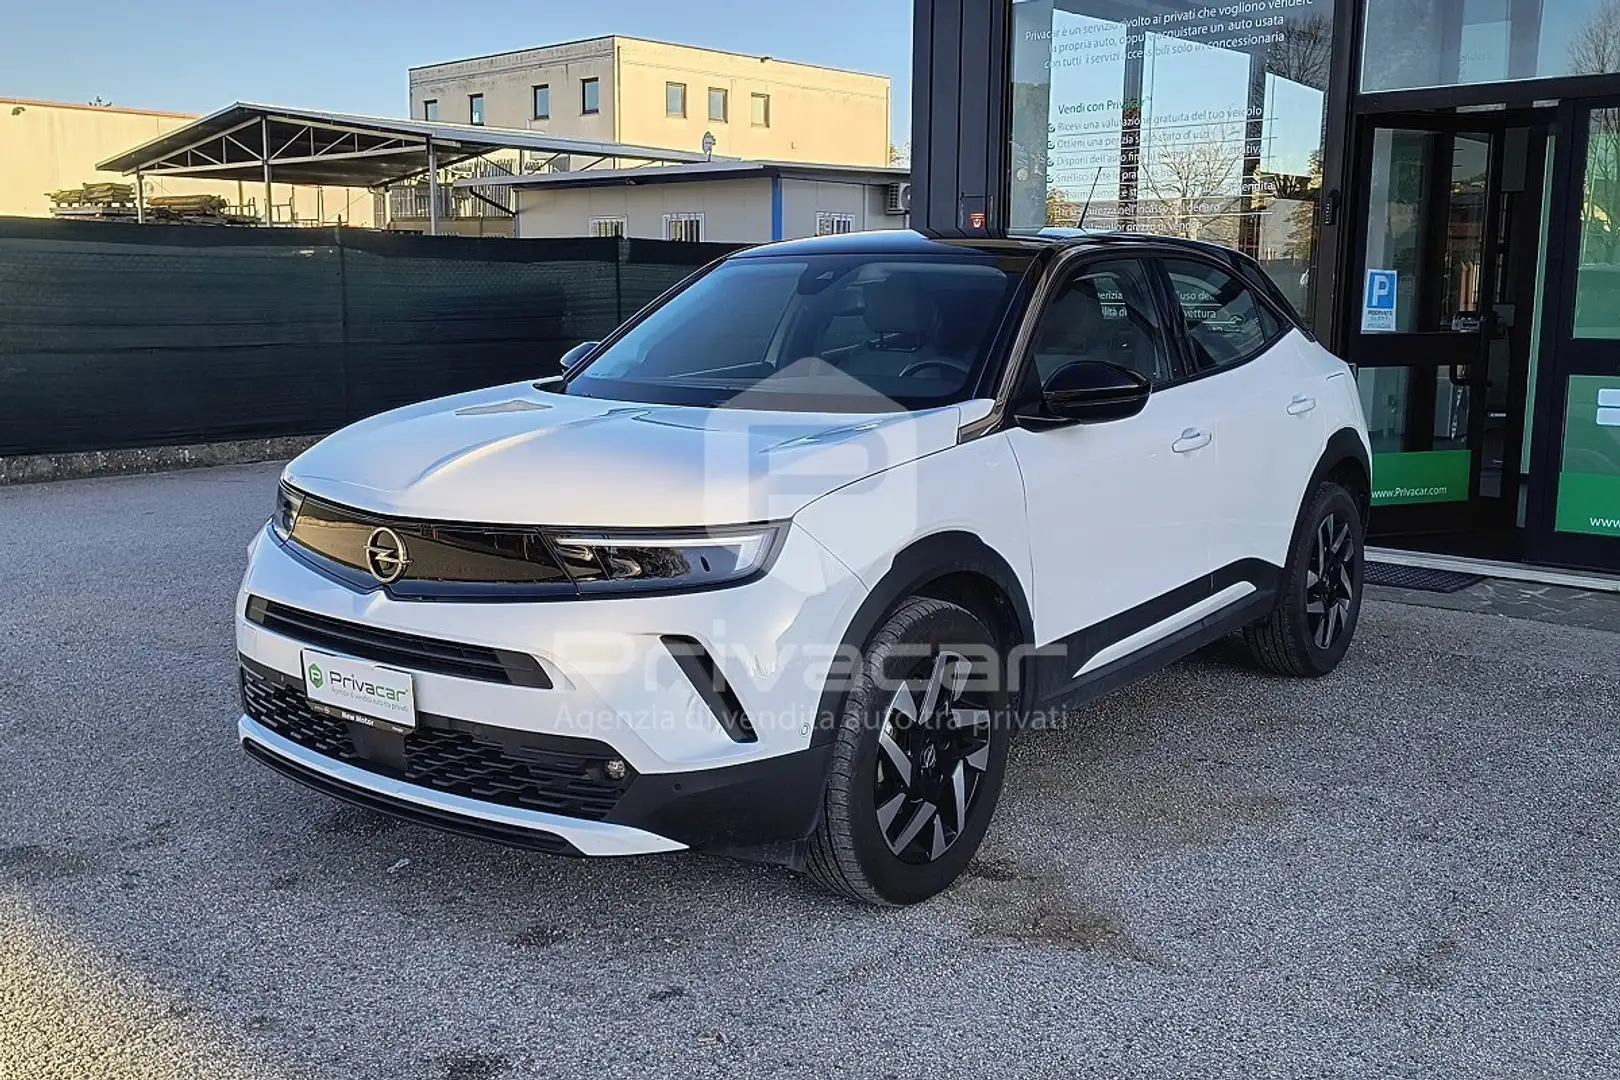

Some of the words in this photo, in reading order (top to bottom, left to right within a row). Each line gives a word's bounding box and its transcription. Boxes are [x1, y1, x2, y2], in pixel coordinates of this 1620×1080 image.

[1069, 27, 1081, 36] un
[1083, 21, 1117, 34] servizio
[1152, 14, 1162, 25] ai
[1163, 8, 1196, 25] privati
[1197, 7, 1217, 18] che
[1218, 0, 1266, 17] vogliono
[1059, 40, 1092, 54] propria
[1210, 23, 1225, 33] un
[1228, 19, 1253, 31] auto
[1255, 15, 1284, 27] usata
[1171, 42, 1193, 54] solo
[1207, 30, 1285, 49] concessionaria
[1058, 103, 1085, 115] Vendi
[1087, 102, 1104, 112] con
[1190, 110, 1206, 121] del
[1371, 275, 1390, 307] P
[1371, 486, 1448, 499] www.Privacar.com
[329, 670, 408, 702] Privacar
